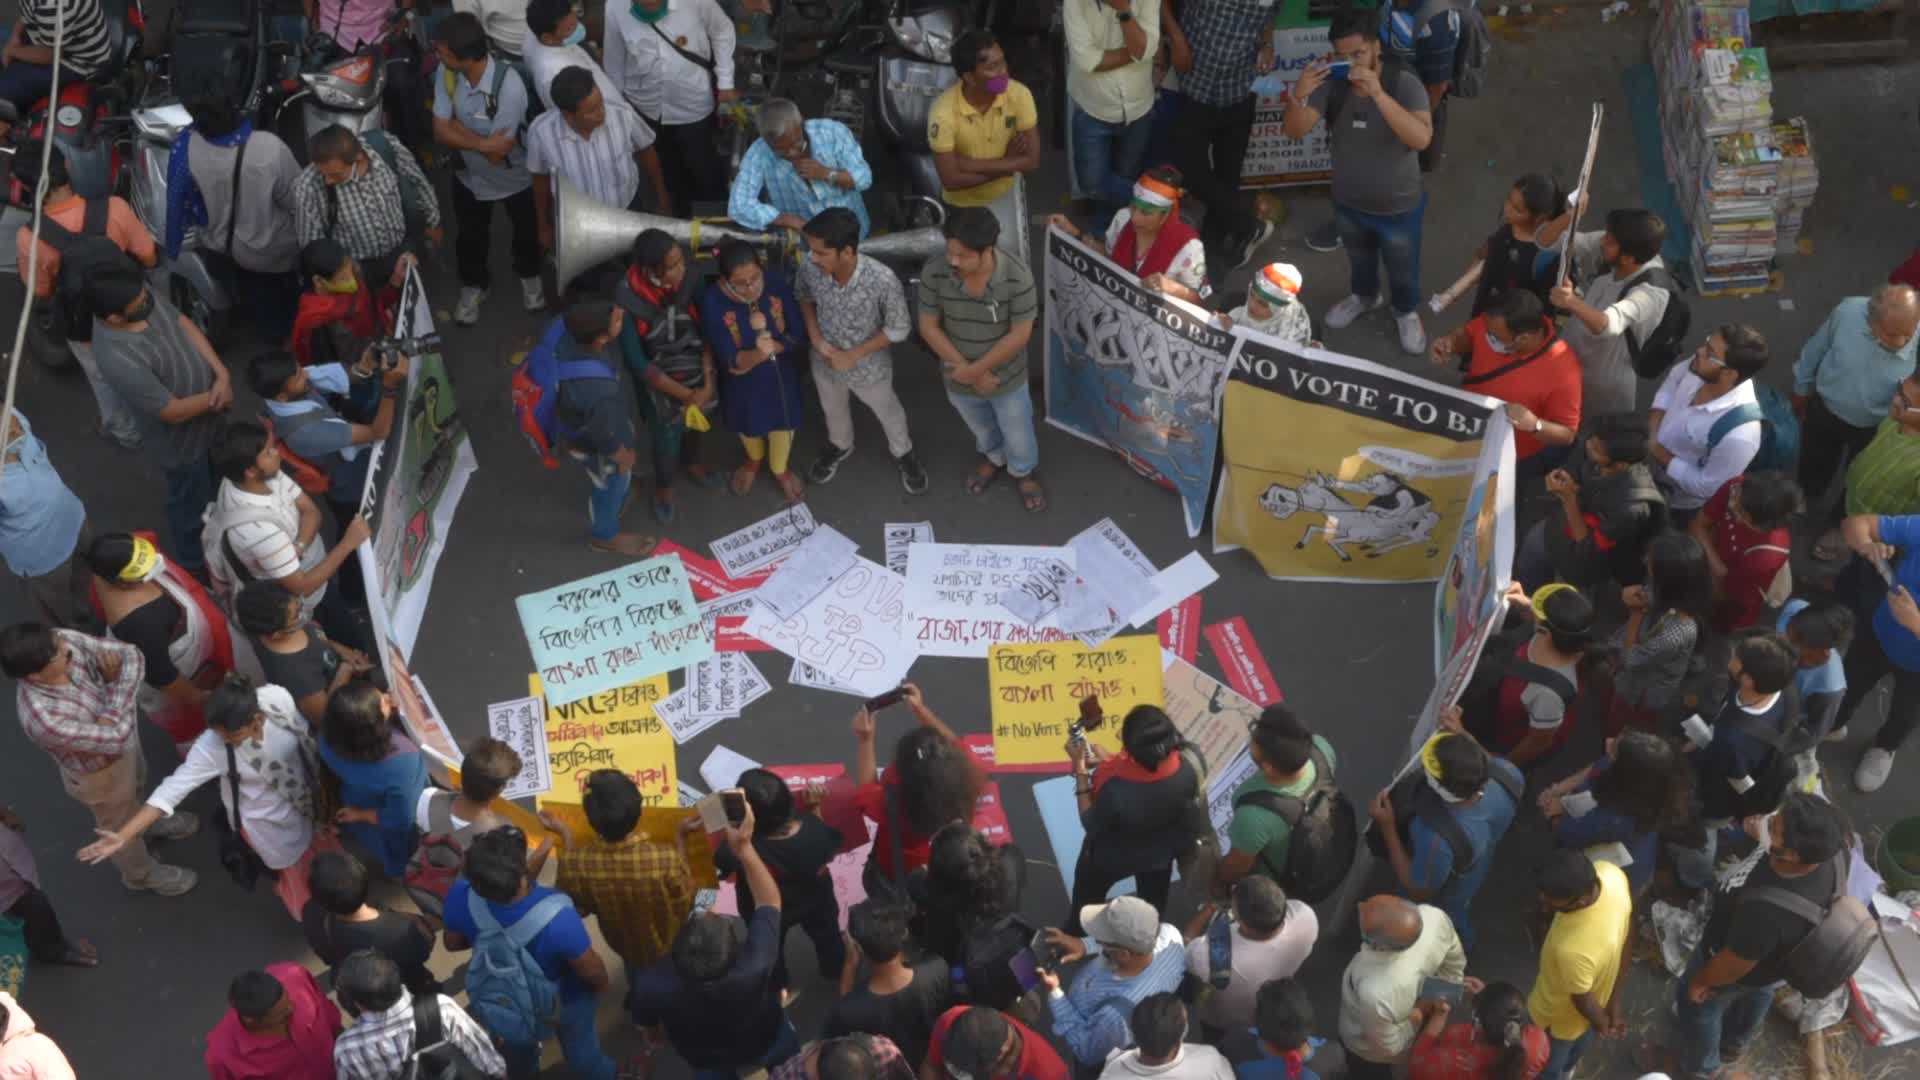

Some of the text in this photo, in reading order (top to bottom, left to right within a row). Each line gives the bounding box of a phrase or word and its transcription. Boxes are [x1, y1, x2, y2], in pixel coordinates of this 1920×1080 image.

[1060, 247, 1227, 347] NO VOTE TO BJP
[1235, 353, 1486, 436] NO VOTE TO BJ
[995, 648, 1057, 676] বিজেপি
[1000, 684, 1055, 704] বাংলা
